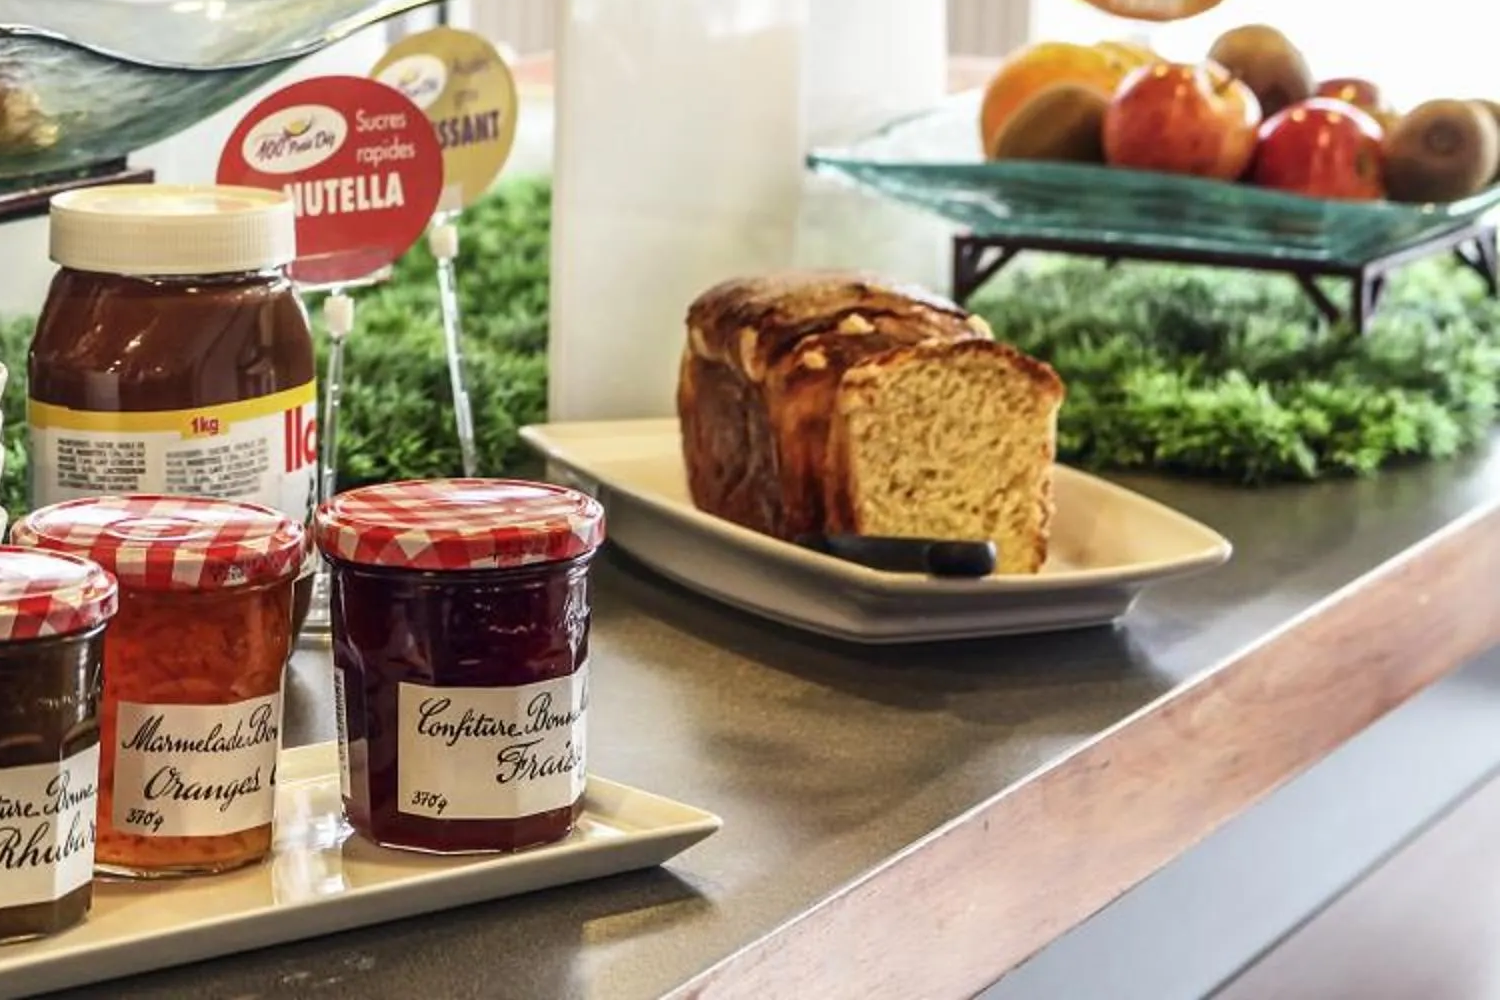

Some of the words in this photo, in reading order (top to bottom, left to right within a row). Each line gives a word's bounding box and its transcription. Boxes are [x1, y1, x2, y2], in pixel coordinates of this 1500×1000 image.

[355, 109, 406, 133] Sucres
[434, 110, 499, 149] SSANT
[356, 138, 415, 167] rapides
[284, 172, 404, 217] NUTELLA
[122, 713, 246, 753] Marmelade
[416, 697, 522, 747] Confiture
[143, 765, 261, 812] Oranges
[411, 790, 448, 815] 370g
[126, 807, 165, 832] 370g
